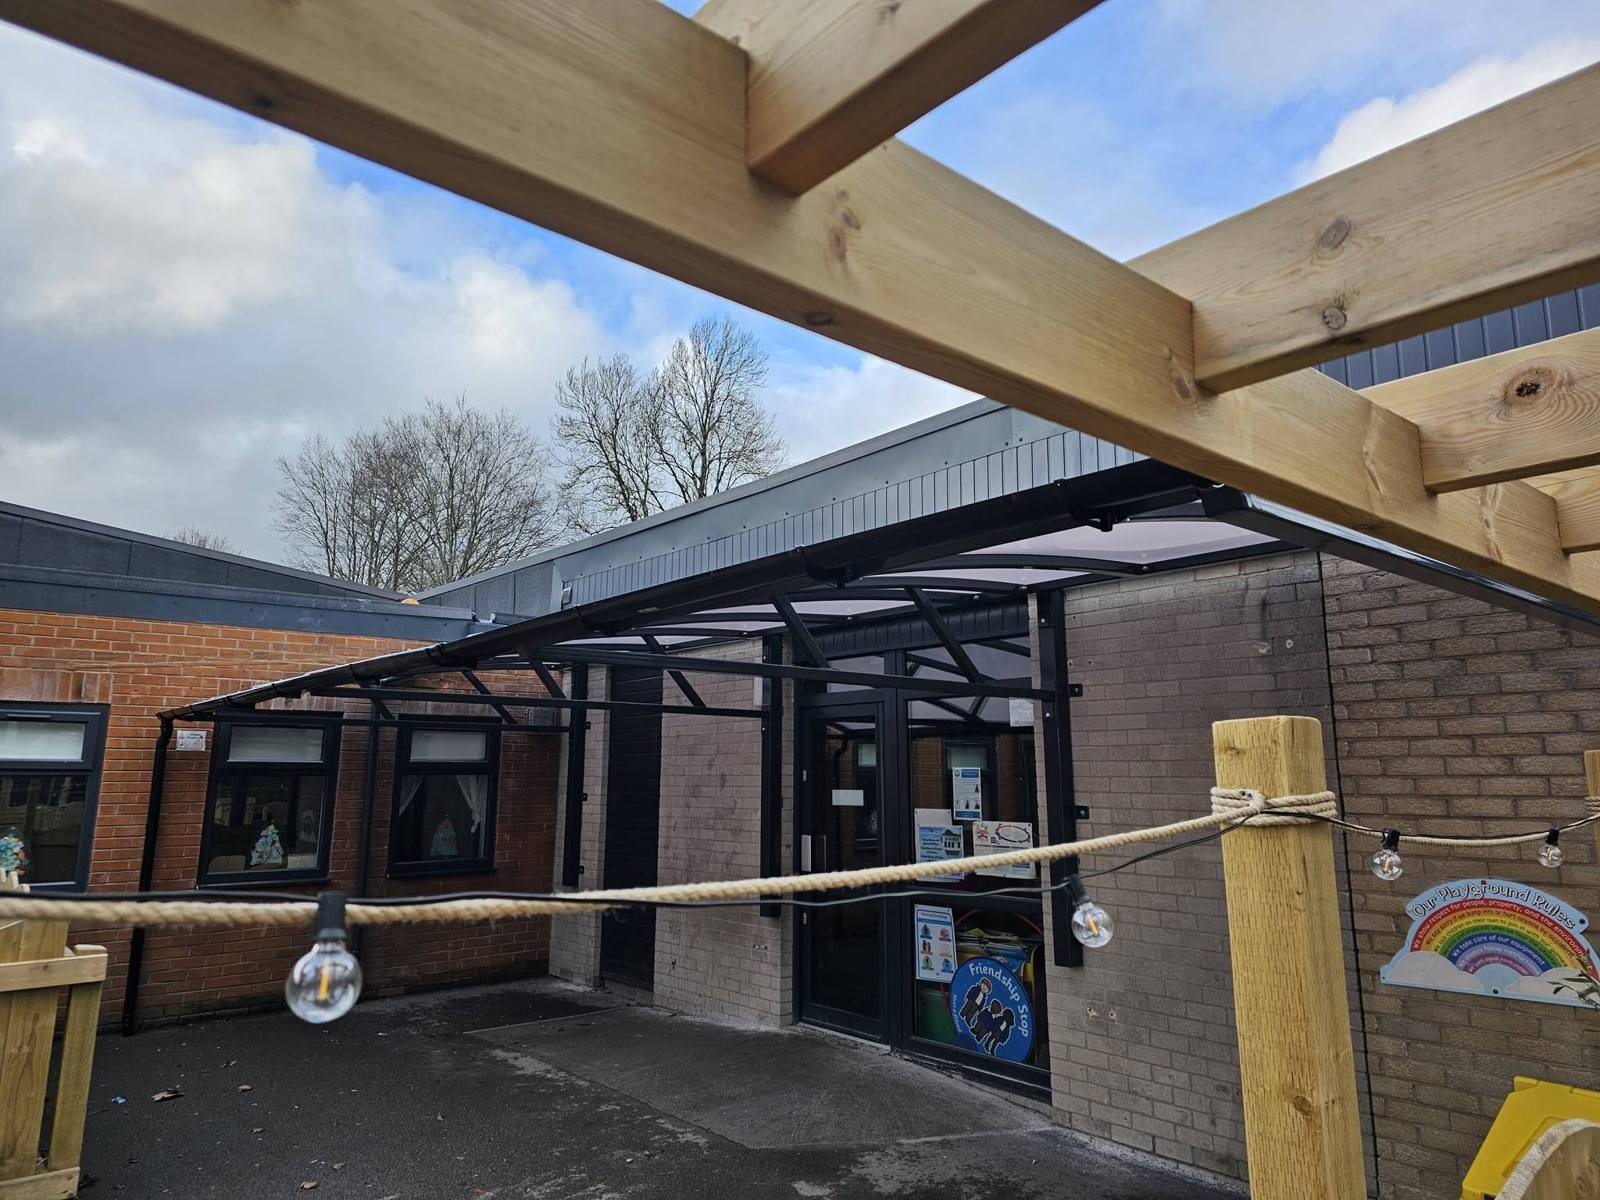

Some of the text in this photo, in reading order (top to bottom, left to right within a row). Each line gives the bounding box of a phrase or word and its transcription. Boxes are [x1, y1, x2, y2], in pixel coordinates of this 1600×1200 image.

[1413, 882, 1576, 930] Our Playground Rules
[1428, 907, 1451, 925] respect
[1450, 902, 1461, 912] for
[1488, 900, 1522, 913] property,
[1524, 907, 1539, 919] and
[1540, 915, 1553, 928] the
[1553, 926, 1593, 970] environmt
[1452, 949, 1460, 958] We
[1459, 940, 1473, 951] take
[1473, 935, 1488, 944] care
[1510, 940, 1545, 966] equipment
[968, 962, 1029, 1037] Friendship Stop
